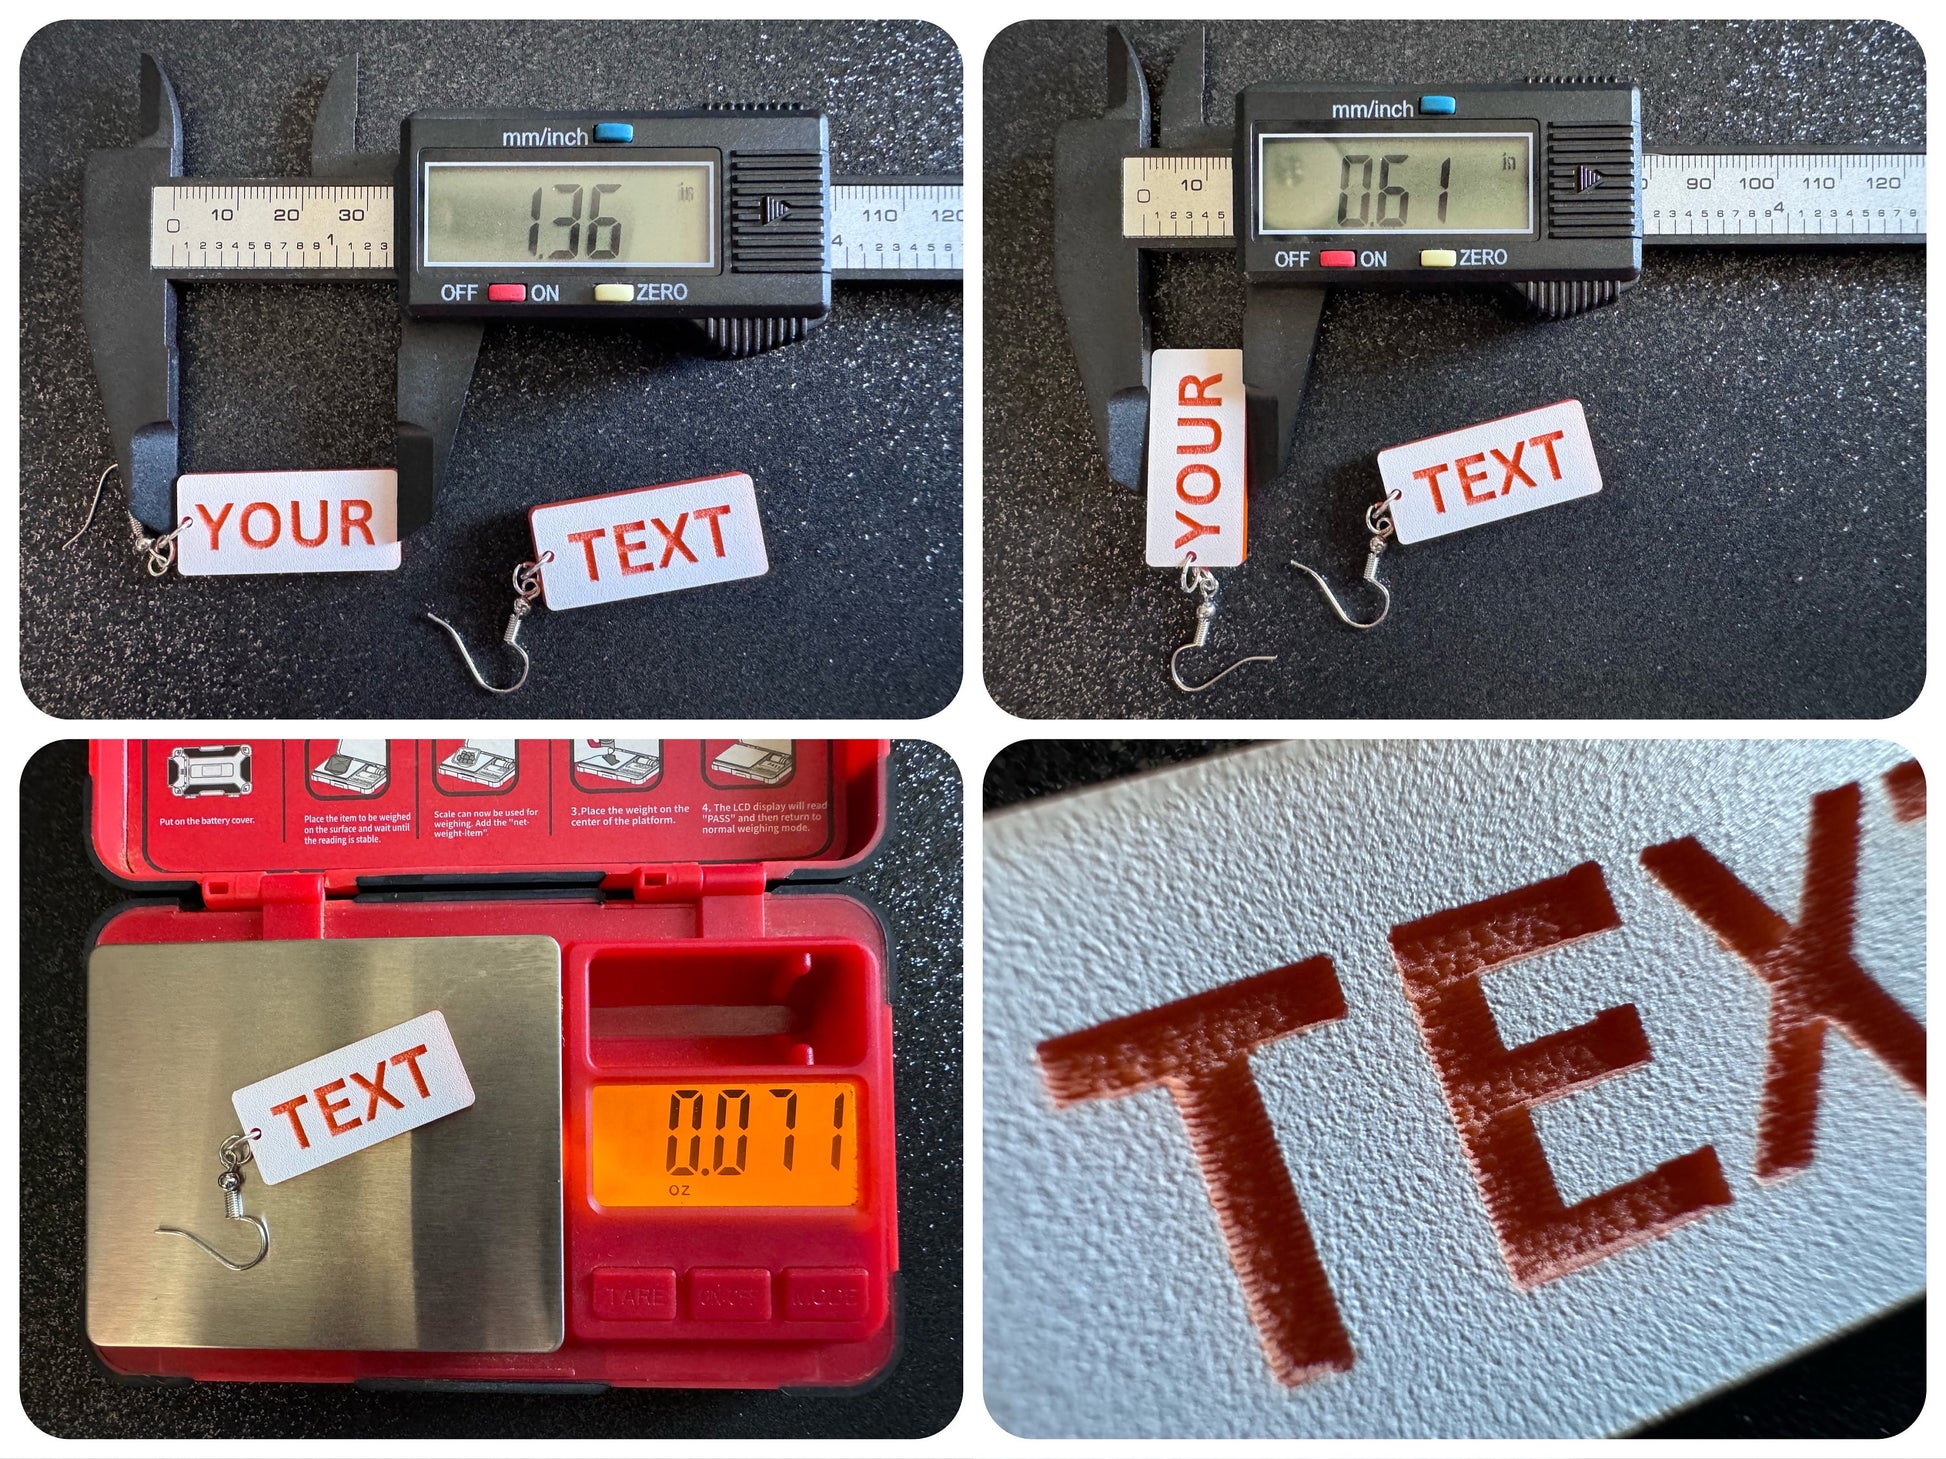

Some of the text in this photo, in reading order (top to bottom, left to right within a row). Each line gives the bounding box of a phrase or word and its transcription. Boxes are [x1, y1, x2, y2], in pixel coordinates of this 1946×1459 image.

[1332, 100, 1414, 118] mm/inch
[502, 127, 589, 146] mm/inch
[1181, 179, 1203, 191] 10
[1337, 152, 1517, 227] 0.61 in
[1686, 177, 1901, 190] 90 100 110 120
[1137, 189, 1151, 203] 0
[1774, 202, 1784, 212] 4
[212, 209, 364, 221] 10 20 30
[528, 182, 695, 260] 1.36 in
[863, 209, 898, 222] 110
[1170, 211, 1177, 219] 2
[1186, 211, 1193, 219] 3
[1202, 211, 1208, 219] 4
[1218, 211, 1224, 219] 5
[166, 219, 180, 233] 0
[297, 242, 304, 250] 8
[313, 242, 320, 250] 9
[327, 234, 333, 245] 1
[364, 242, 371, 250] 2
[381, 242, 388, 250] 3
[832, 234, 843, 246] 4
[859, 243, 863, 251] 1
[875, 243, 883, 251] 2
[1275, 249, 1508, 268] OFF ON ZERO
[441, 283, 688, 302] OFF ON ZERO
[1174, 372, 1224, 550] YOUR
[1413, 430, 1564, 515] TEXT
[196, 499, 374, 551] YOUR
[567, 505, 732, 582] TEXT
[526, 808, 538, 816] for
[571, 807, 605, 816] 3.Place
[608, 806, 623, 814] the
[626, 805, 657, 815] weight
[674, 804, 689, 812] the
[702, 804, 711, 812] 4.
[753, 802, 786, 812] display
[788, 802, 804, 810] will
[807, 801, 827, 809] read
[202, 817, 230, 825] battery
[304, 815, 324, 823] Place
[326, 814, 338, 822] the
[340, 814, 356, 822] item
[368, 813, 377, 821] be
[379, 812, 411, 823] weighed
[571, 816, 676, 826] center of the platform.
[702, 814, 735, 823] "PASS"
[738, 814, 755, 822] and
[330, 825, 356, 833] surface
[358, 824, 372, 832] and
[374, 824, 390, 832] wait
[392, 823, 410, 831] until
[434, 821, 473, 829] weighing.
[703, 824, 810, 834] normal weighing mode.
[304, 835, 381, 845] the reading is stable.
[1036, 760, 1926, 1388] TEX
[270, 1043, 429, 1150] TEXT
[666, 1089, 844, 1176] 0.071
[606, 1288, 666, 1306] TARE
